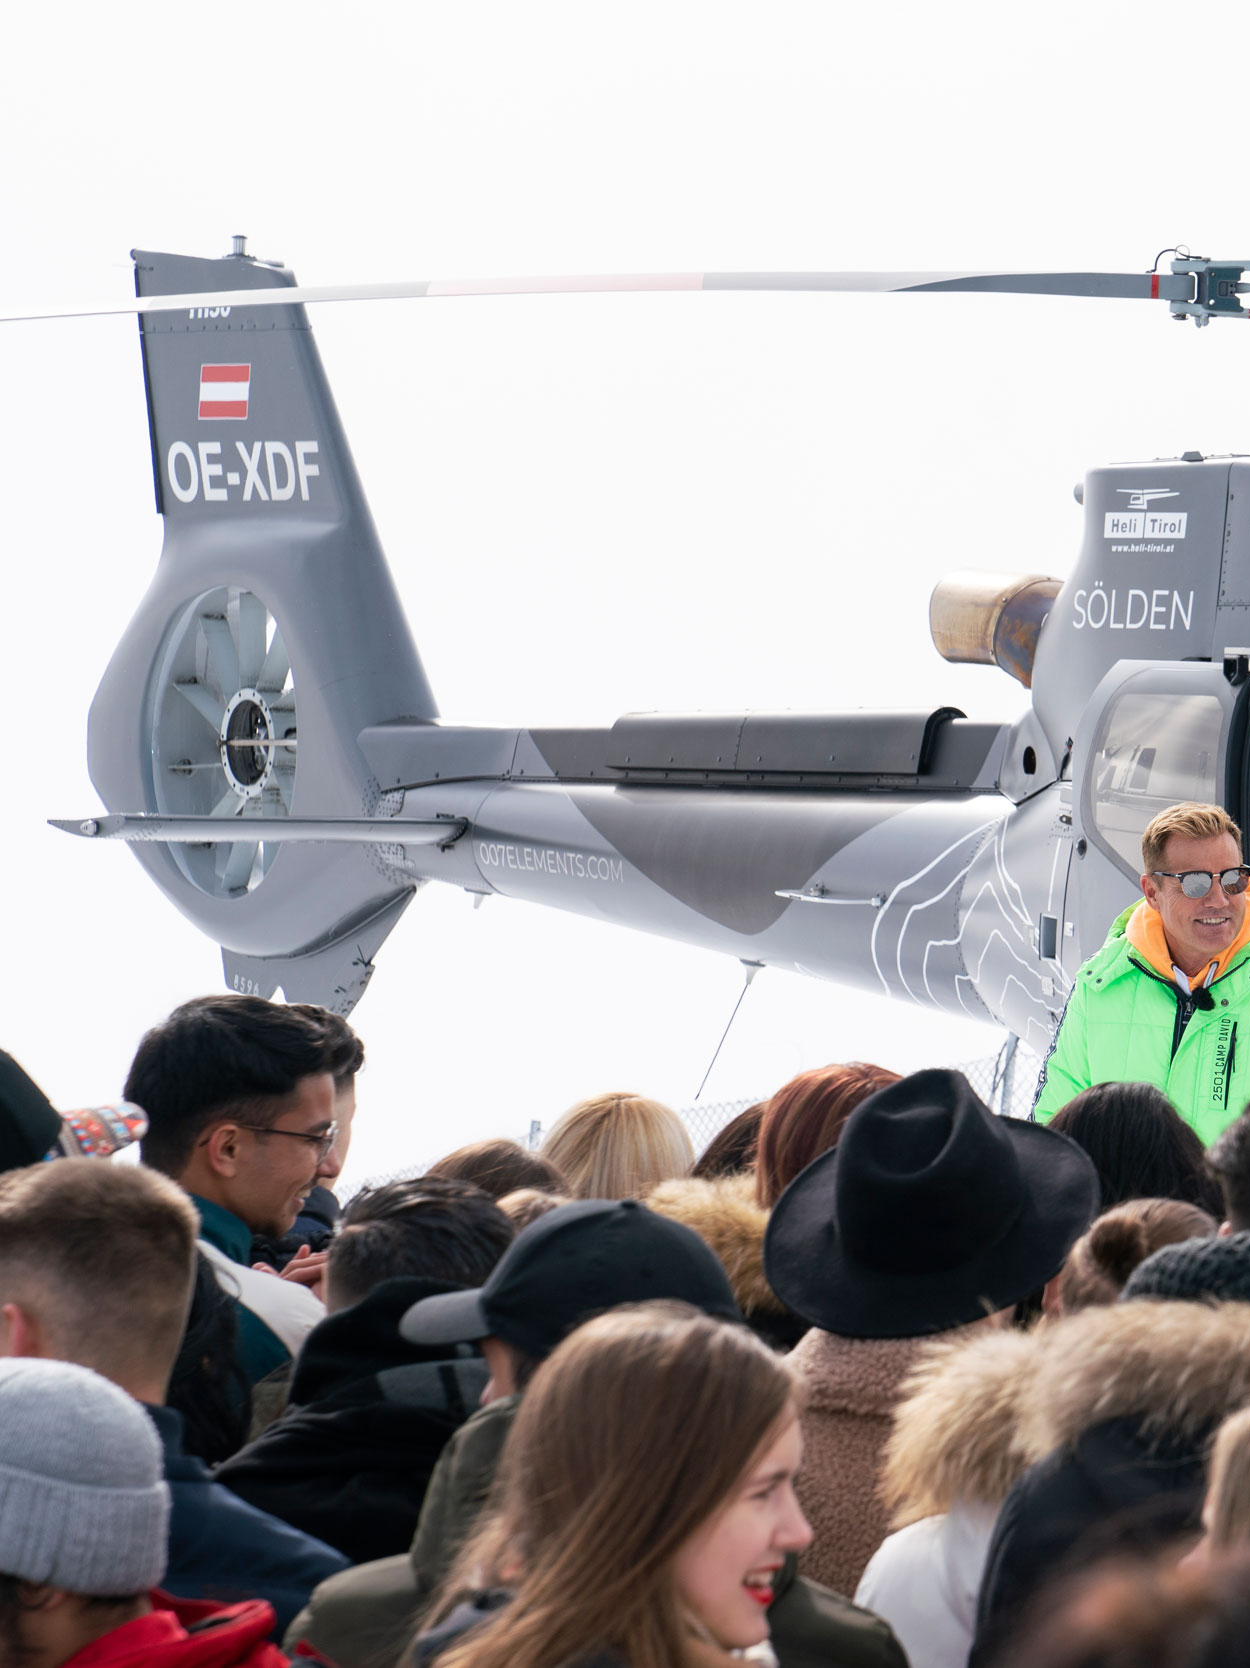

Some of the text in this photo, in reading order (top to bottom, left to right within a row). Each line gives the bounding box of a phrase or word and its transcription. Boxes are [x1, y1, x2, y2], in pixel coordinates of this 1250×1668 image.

[167, 440, 320, 503] OE-XDF
[1111, 518, 1182, 533] Heli Tirol
[1111, 543, 1175, 553] www.heli-tirol.at
[1072, 580, 1194, 631] SÖLDEN
[479, 842, 624, 884] 007ELEMENTS.COM
[1218, 1018, 1232, 1041] DAVID
[1215, 1044, 1227, 1067] CAMP
